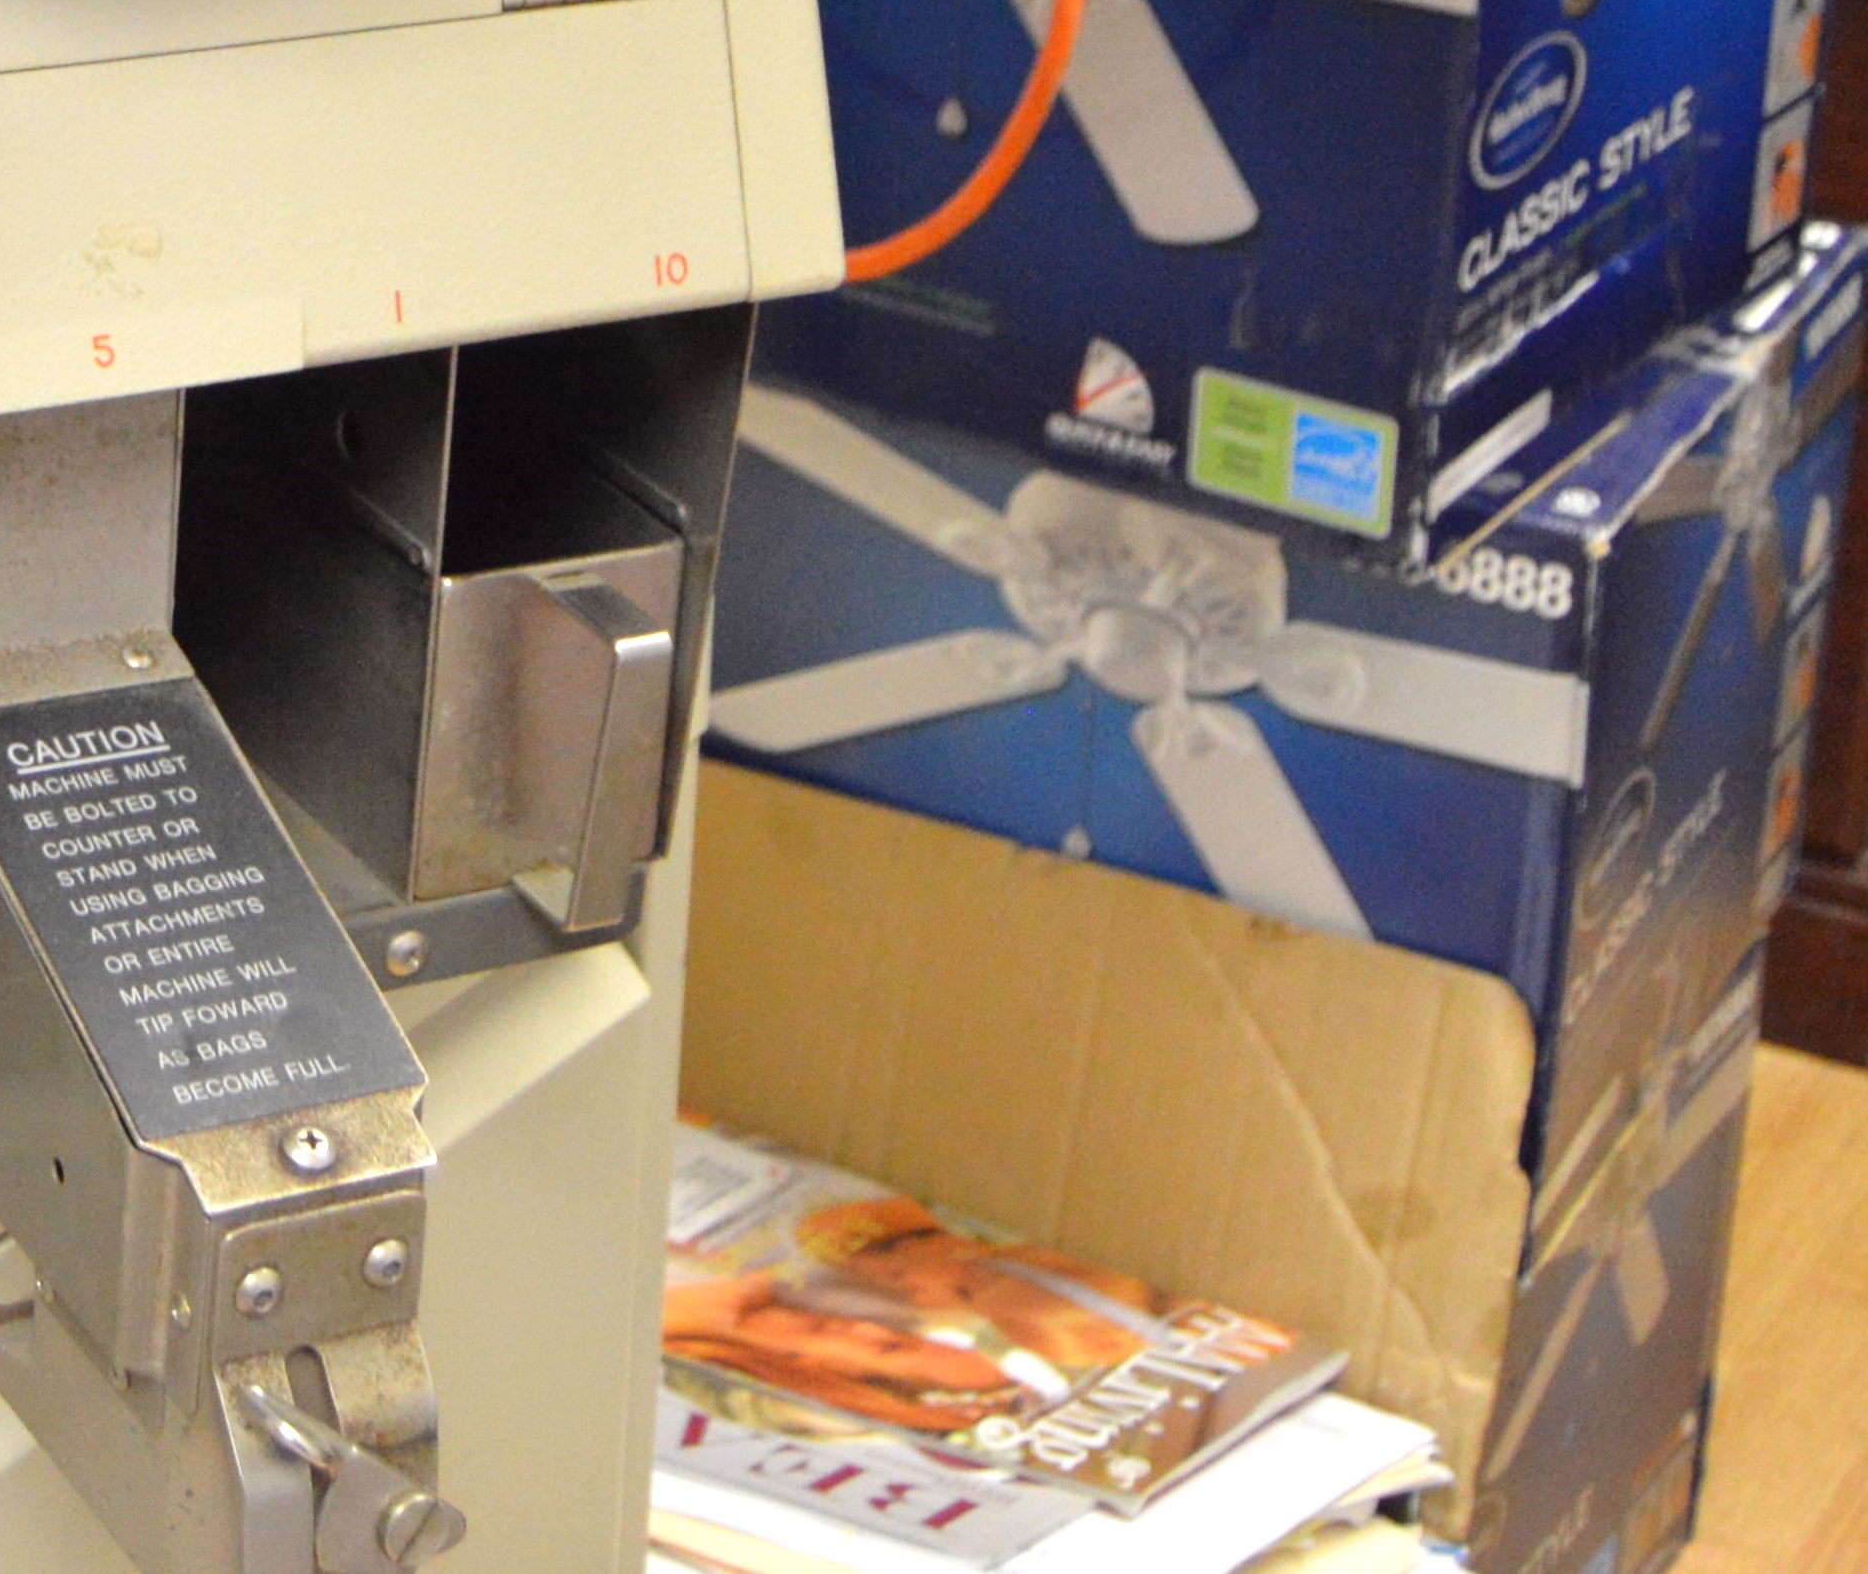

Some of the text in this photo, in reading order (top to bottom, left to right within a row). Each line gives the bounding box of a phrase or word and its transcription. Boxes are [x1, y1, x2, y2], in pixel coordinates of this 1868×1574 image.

[1457, 157, 1591, 294] CLASSIC
[1597, 84, 1696, 191] STYLE
[654, 252, 690, 287] 10
[91, 333, 116, 369] 5
[7, 720, 166, 769] CAUTION
[9, 755, 189, 801] MACHINE MUST
[24, 786, 198, 831] BE BOLTED TO
[42, 817, 200, 860] COUNTER OR
[56, 844, 217, 887] STAND WHEN
[71, 865, 265, 918] USING BAGGING
[89, 896, 265, 945] ATTACHMENTS
[104, 934, 235, 974] OR ENTIRE
[120, 956, 297, 1007] MACHINE WILL
[136, 991, 289, 1037] TIP FOWARD
[158, 1030, 268, 1070] AS BAGS
[172, 1054, 351, 1105] BECOME FULL.
